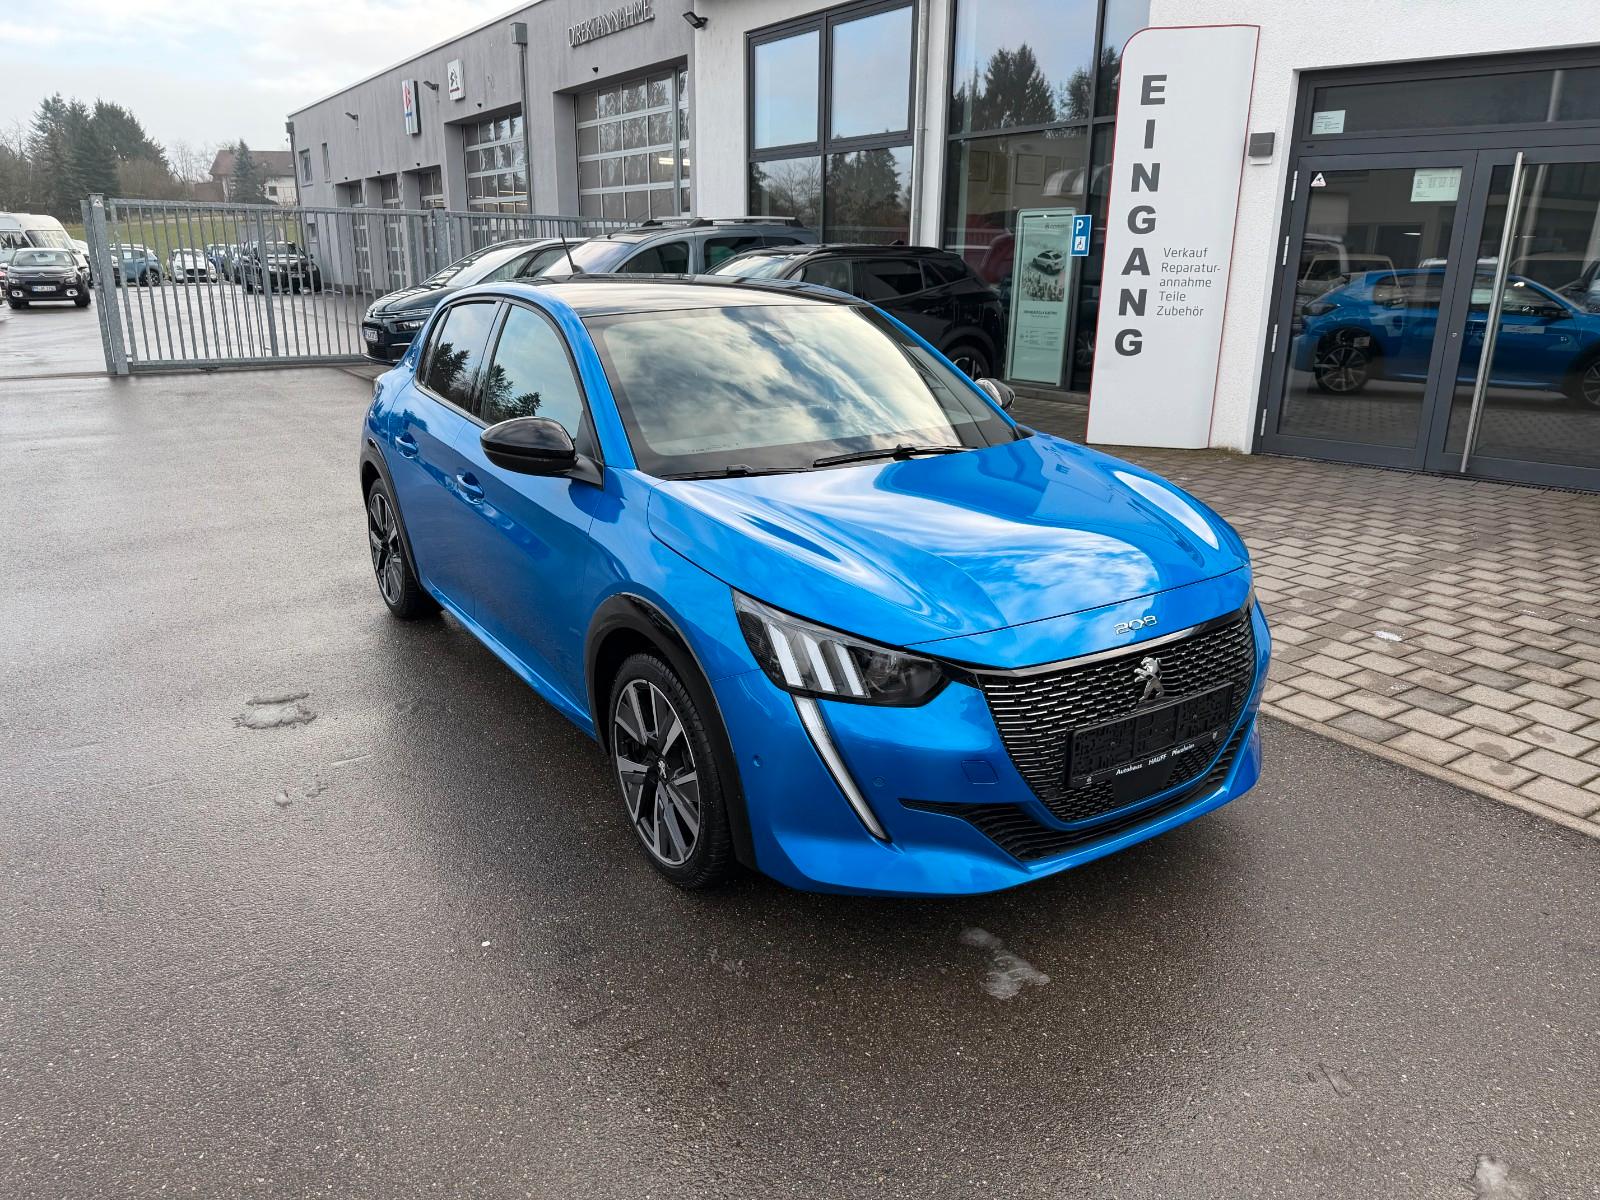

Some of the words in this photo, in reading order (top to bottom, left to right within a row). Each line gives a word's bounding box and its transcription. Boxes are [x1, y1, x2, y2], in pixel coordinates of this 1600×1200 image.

[567, 0, 652, 47] DIREKTANNAHME
[1114, 74, 1168, 357] EINGANG
[1075, 219, 1084, 235] P
[1163, 247, 1208, 258] Verkauf
[1161, 262, 1221, 275] Reparatur-
[1159, 276, 1212, 288] annahme
[1159, 291, 1187, 302] Teile
[1156, 305, 1205, 317] Zubehör
[1113, 615, 1158, 635] 208
[1115, 763, 1143, 776] Autohaus
[1148, 753, 1168, 766] HAUFF
